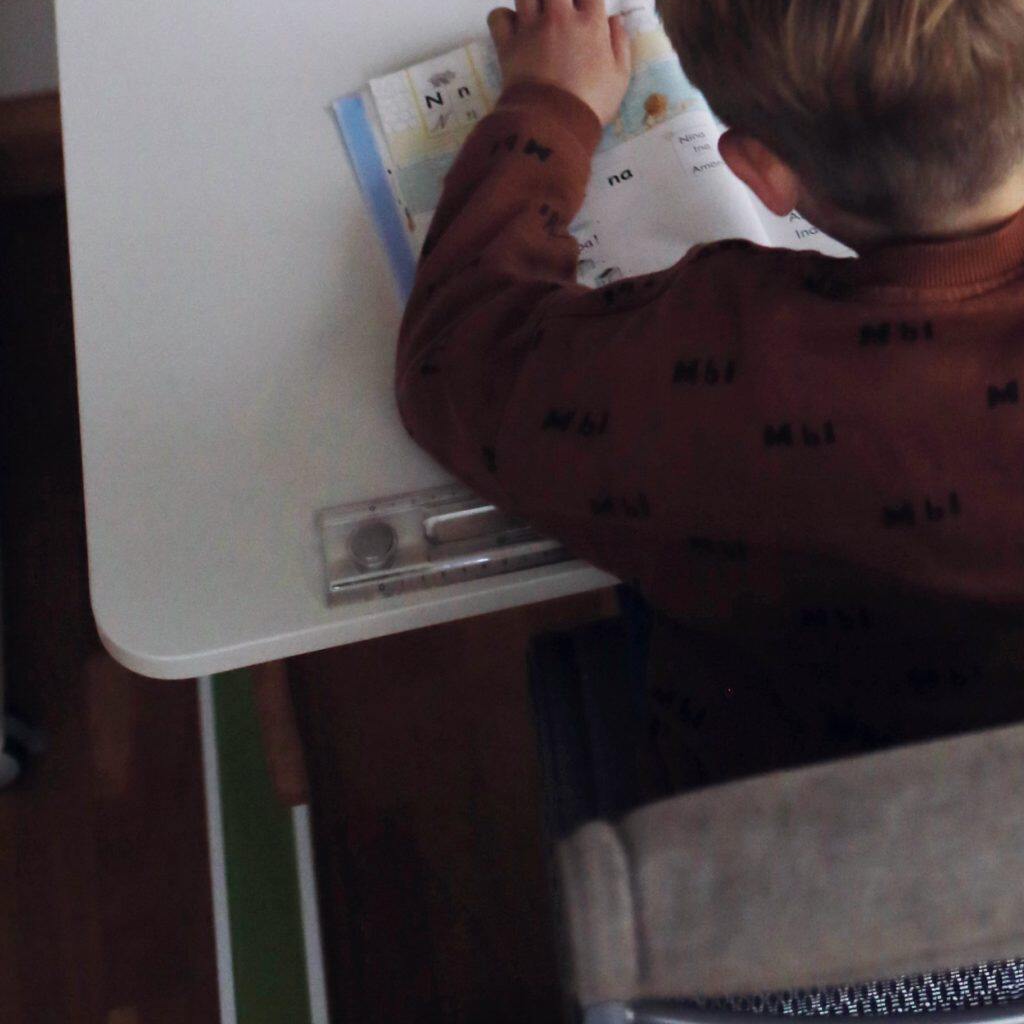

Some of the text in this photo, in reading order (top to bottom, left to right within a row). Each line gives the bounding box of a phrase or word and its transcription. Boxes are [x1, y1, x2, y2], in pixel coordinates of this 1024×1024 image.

[424, 86, 470, 109] N n
[607, 168, 634, 187] na
